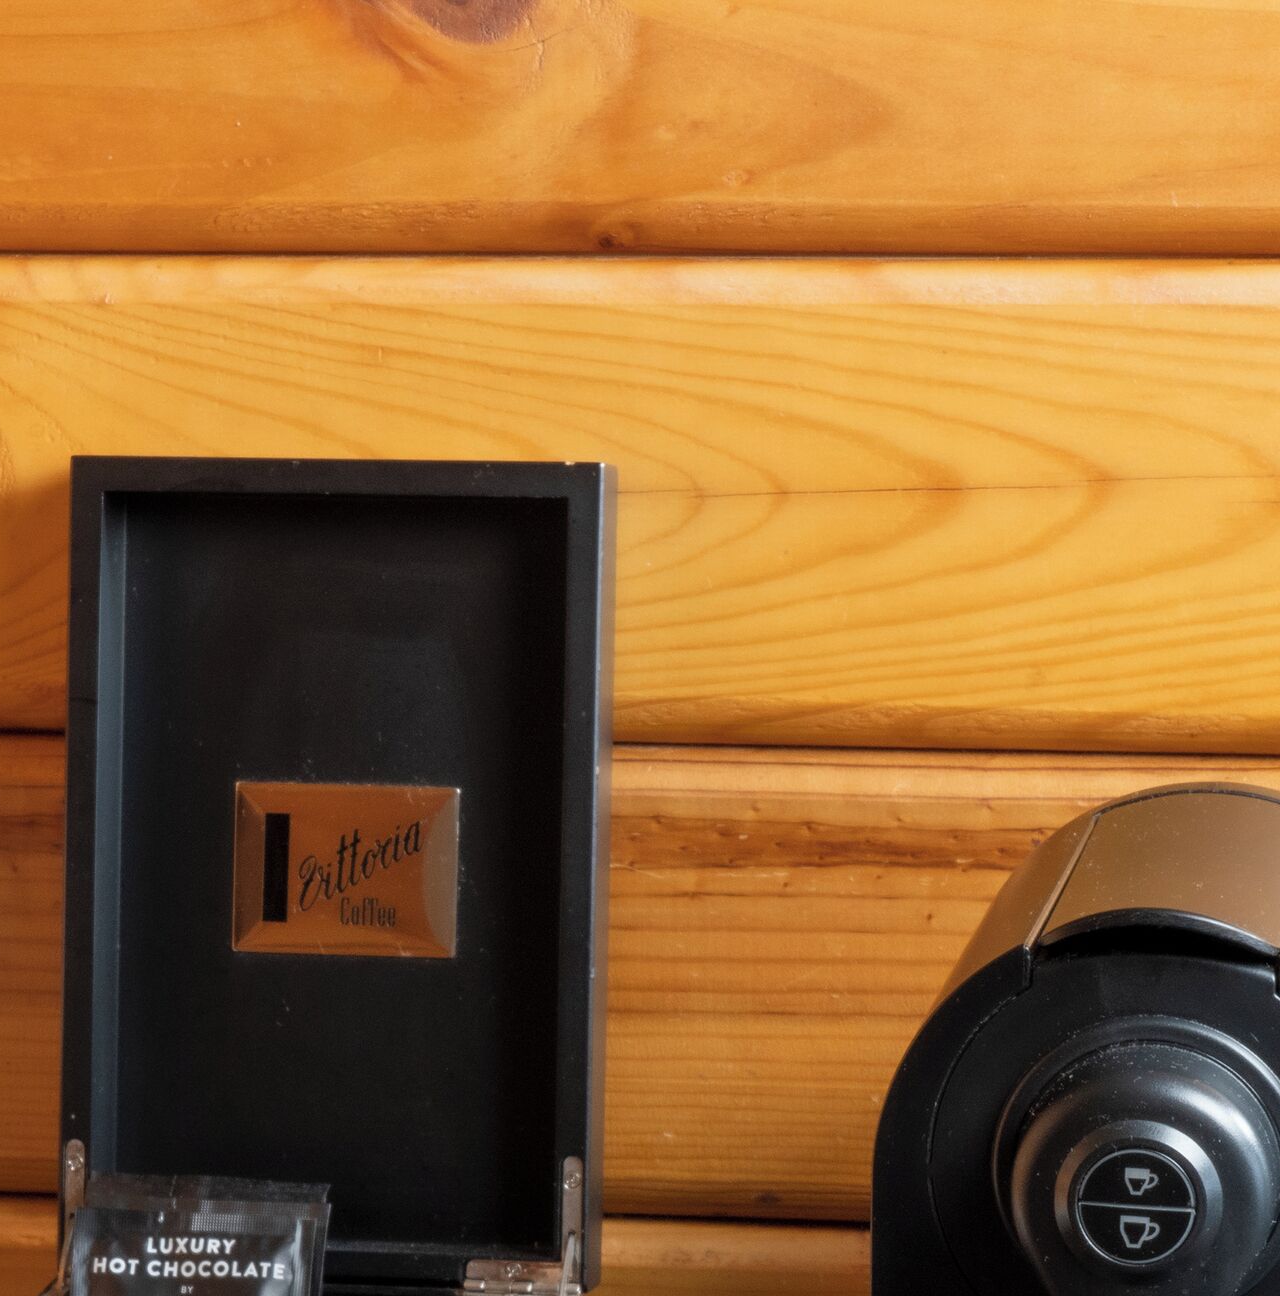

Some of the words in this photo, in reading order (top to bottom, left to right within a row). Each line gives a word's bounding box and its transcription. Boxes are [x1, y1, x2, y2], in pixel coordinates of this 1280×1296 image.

[339, 897, 396, 927] Coffee
[147, 1237, 236, 1255] LUXURY
[92, 1257, 140, 1276] HOT
[146, 1260, 286, 1280] CHOCOLATE
[180, 1284, 194, 1295] BY
